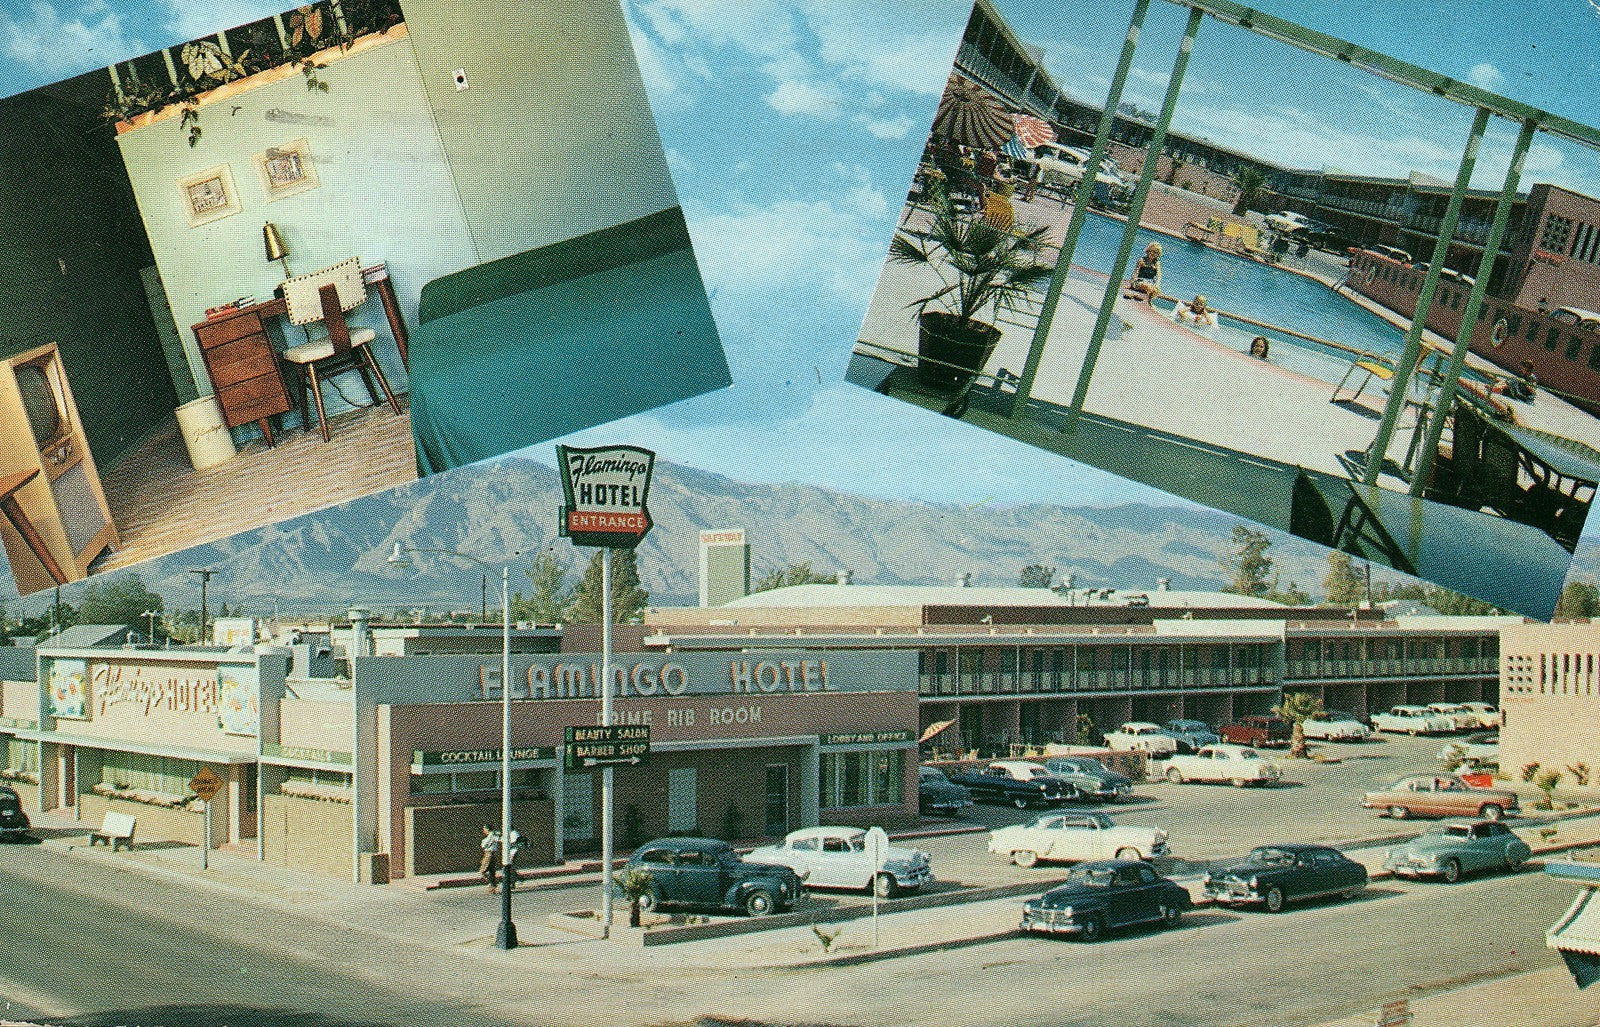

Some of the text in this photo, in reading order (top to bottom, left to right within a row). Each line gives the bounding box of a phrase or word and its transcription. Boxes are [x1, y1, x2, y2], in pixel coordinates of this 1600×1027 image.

[570, 454, 647, 488] Flamingo
[580, 483, 641, 506] HOTEL
[572, 515, 644, 528] ENTRANCE
[480, 660, 836, 699] FAMINGO HOTEL
[166, 678, 218, 713] HOTEL
[668, 708, 695, 727] RIB
[710, 706, 762, 726] ROOM
[575, 728, 648, 740] BEAUTY SALON
[441, 748, 540, 763] COCKTAIL LUNGE
[577, 744, 647, 757] BARBER SHOP
